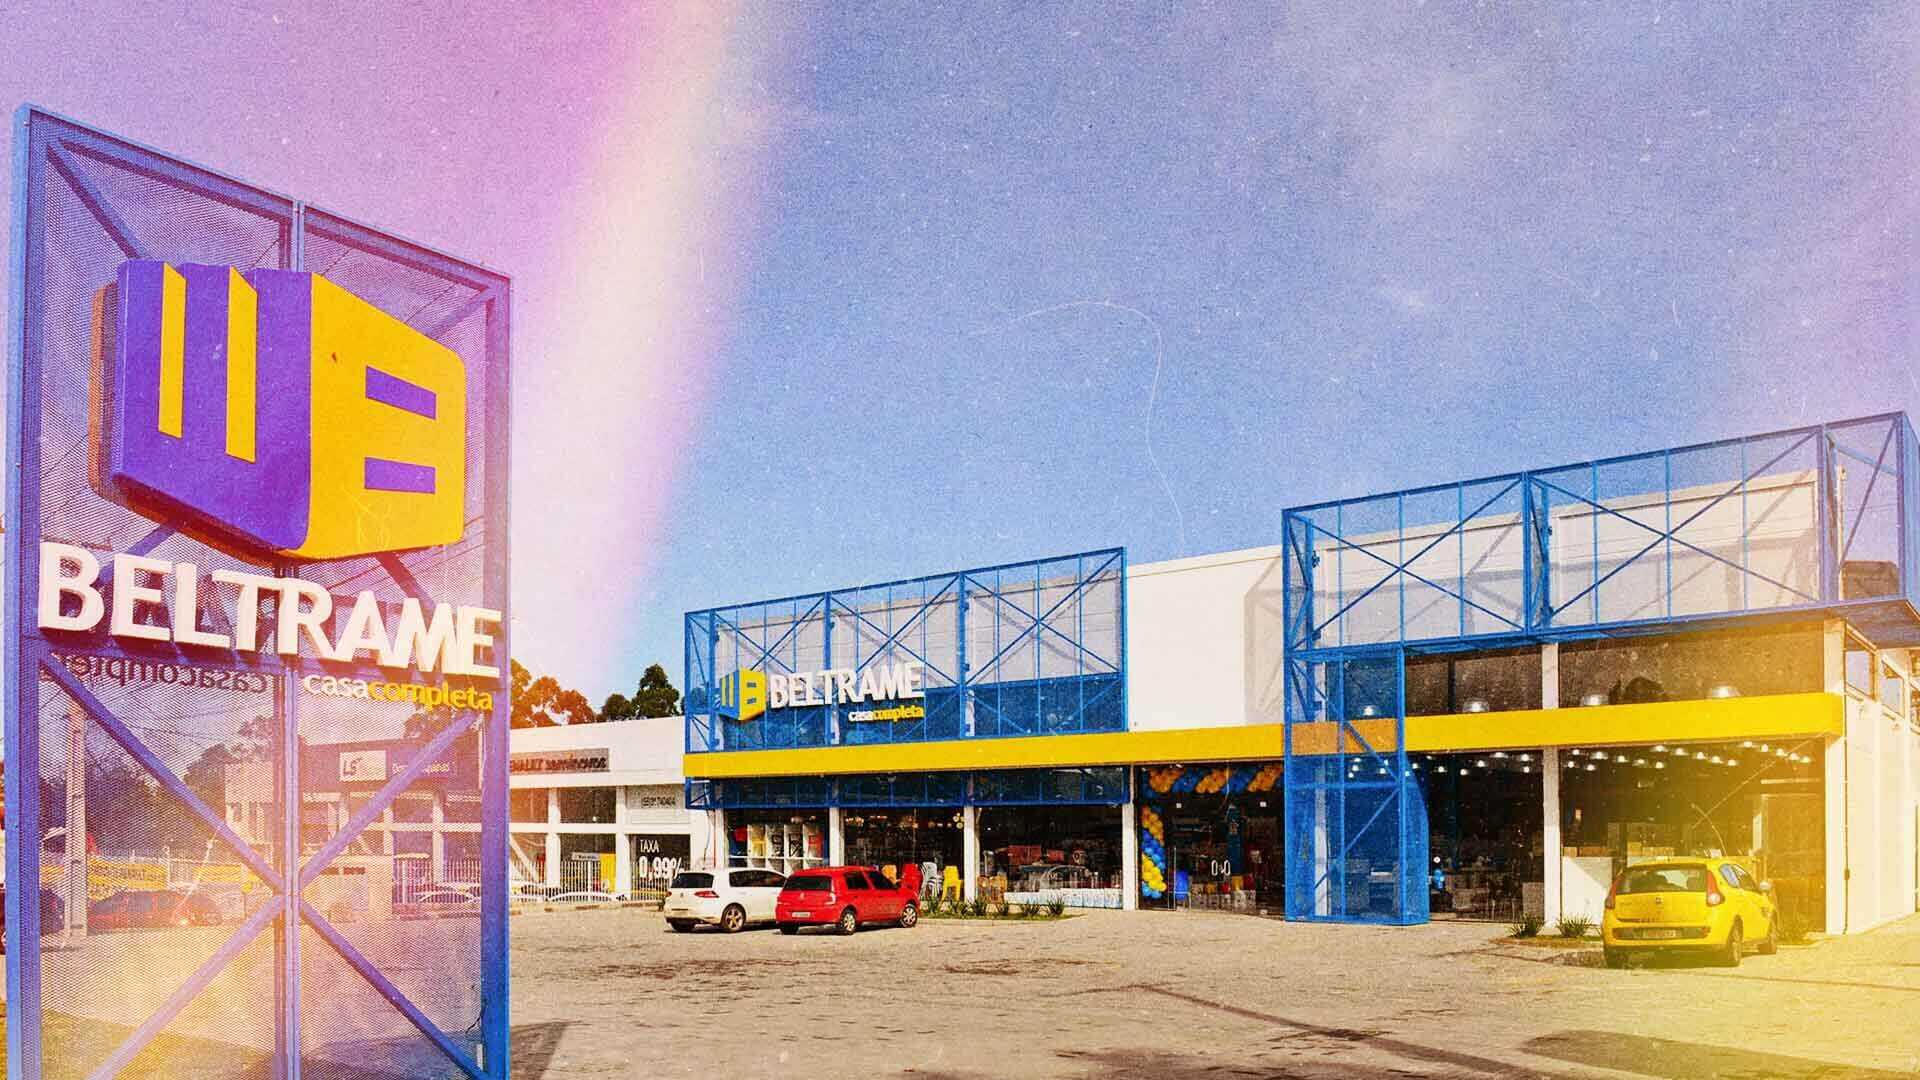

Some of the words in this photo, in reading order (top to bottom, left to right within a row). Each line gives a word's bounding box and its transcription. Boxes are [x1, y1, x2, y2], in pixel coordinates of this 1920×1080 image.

[38, 541, 502, 678] BELTRAME
[769, 661, 925, 709] BELTRAME
[640, 839, 660, 853] TAXA
